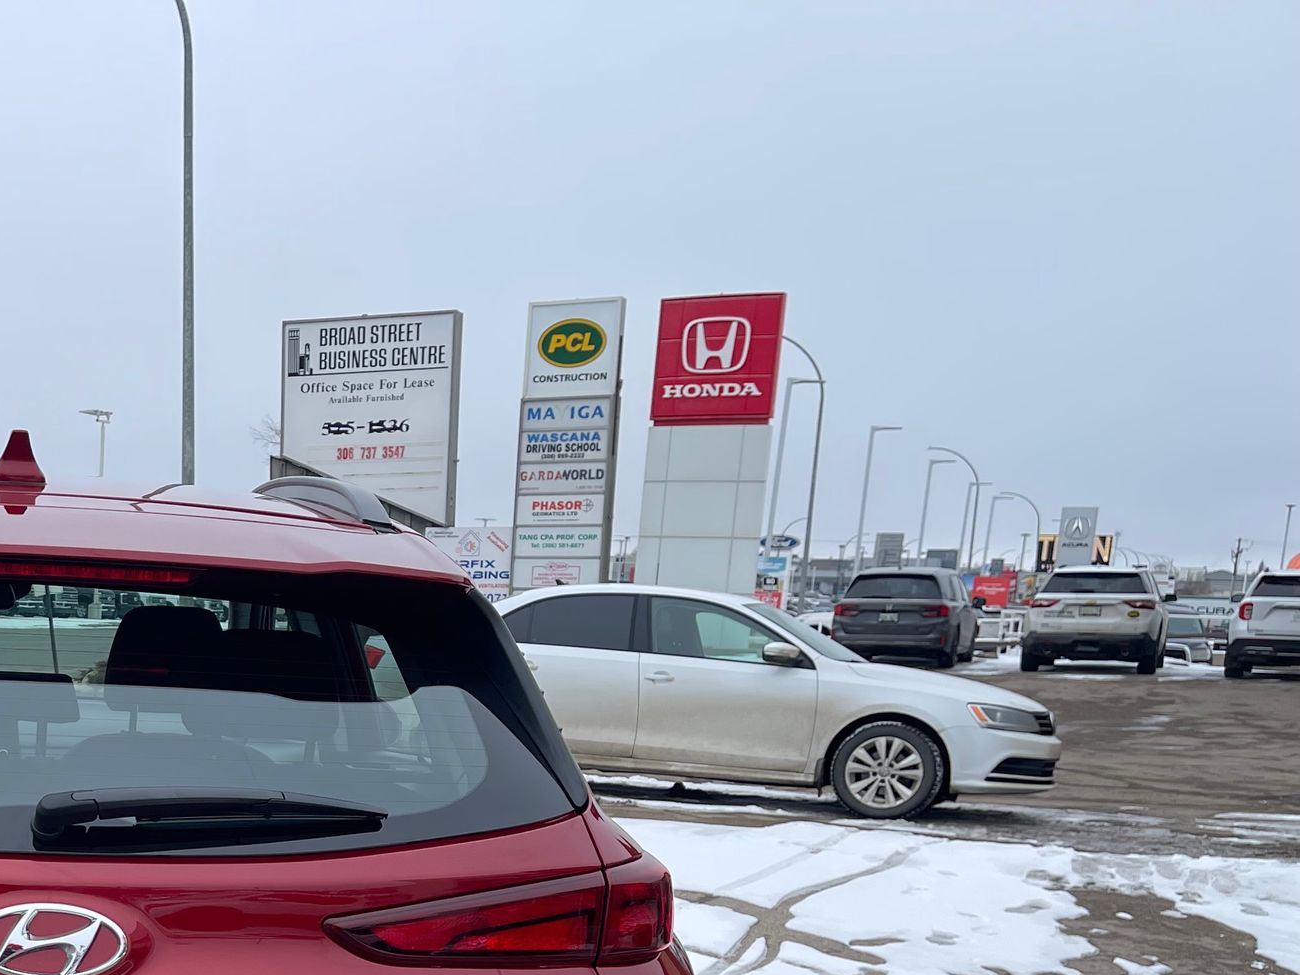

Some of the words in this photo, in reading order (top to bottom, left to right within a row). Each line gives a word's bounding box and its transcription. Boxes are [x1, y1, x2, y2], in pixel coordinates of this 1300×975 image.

[319, 326, 366, 347] BROAD
[370, 322, 423, 344] STREET
[548, 332, 595, 353] PCL
[319, 347, 387, 371] BUSINESS
[391, 344, 446, 367] CENTRE
[532, 371, 608, 384] CONSTRUCTION
[300, 381, 338, 394] Office
[341, 380, 375, 394] Space
[379, 378, 399, 390] For
[403, 377, 436, 389] Lease
[661, 382, 762, 399] HONDA
[328, 395, 363, 405] Available
[365, 393, 405, 402] Furnished
[526, 404, 605, 421] MAIGA
[526, 431, 601, 444] WASCANA
[336, 447, 354, 461] 306
[360, 446, 378, 460] 737
[382, 445, 406, 460] 3547
[525, 443, 563, 454] DRIVING
[564, 442, 602, 453] SCHOOL
[519, 468, 605, 482] GARDAWORLD
[531, 500, 583, 511] PHASOR
[456, 559, 497, 569] RFIX
[468, 570, 510, 580] BING
[1192, 605, 1236, 616] CURA
